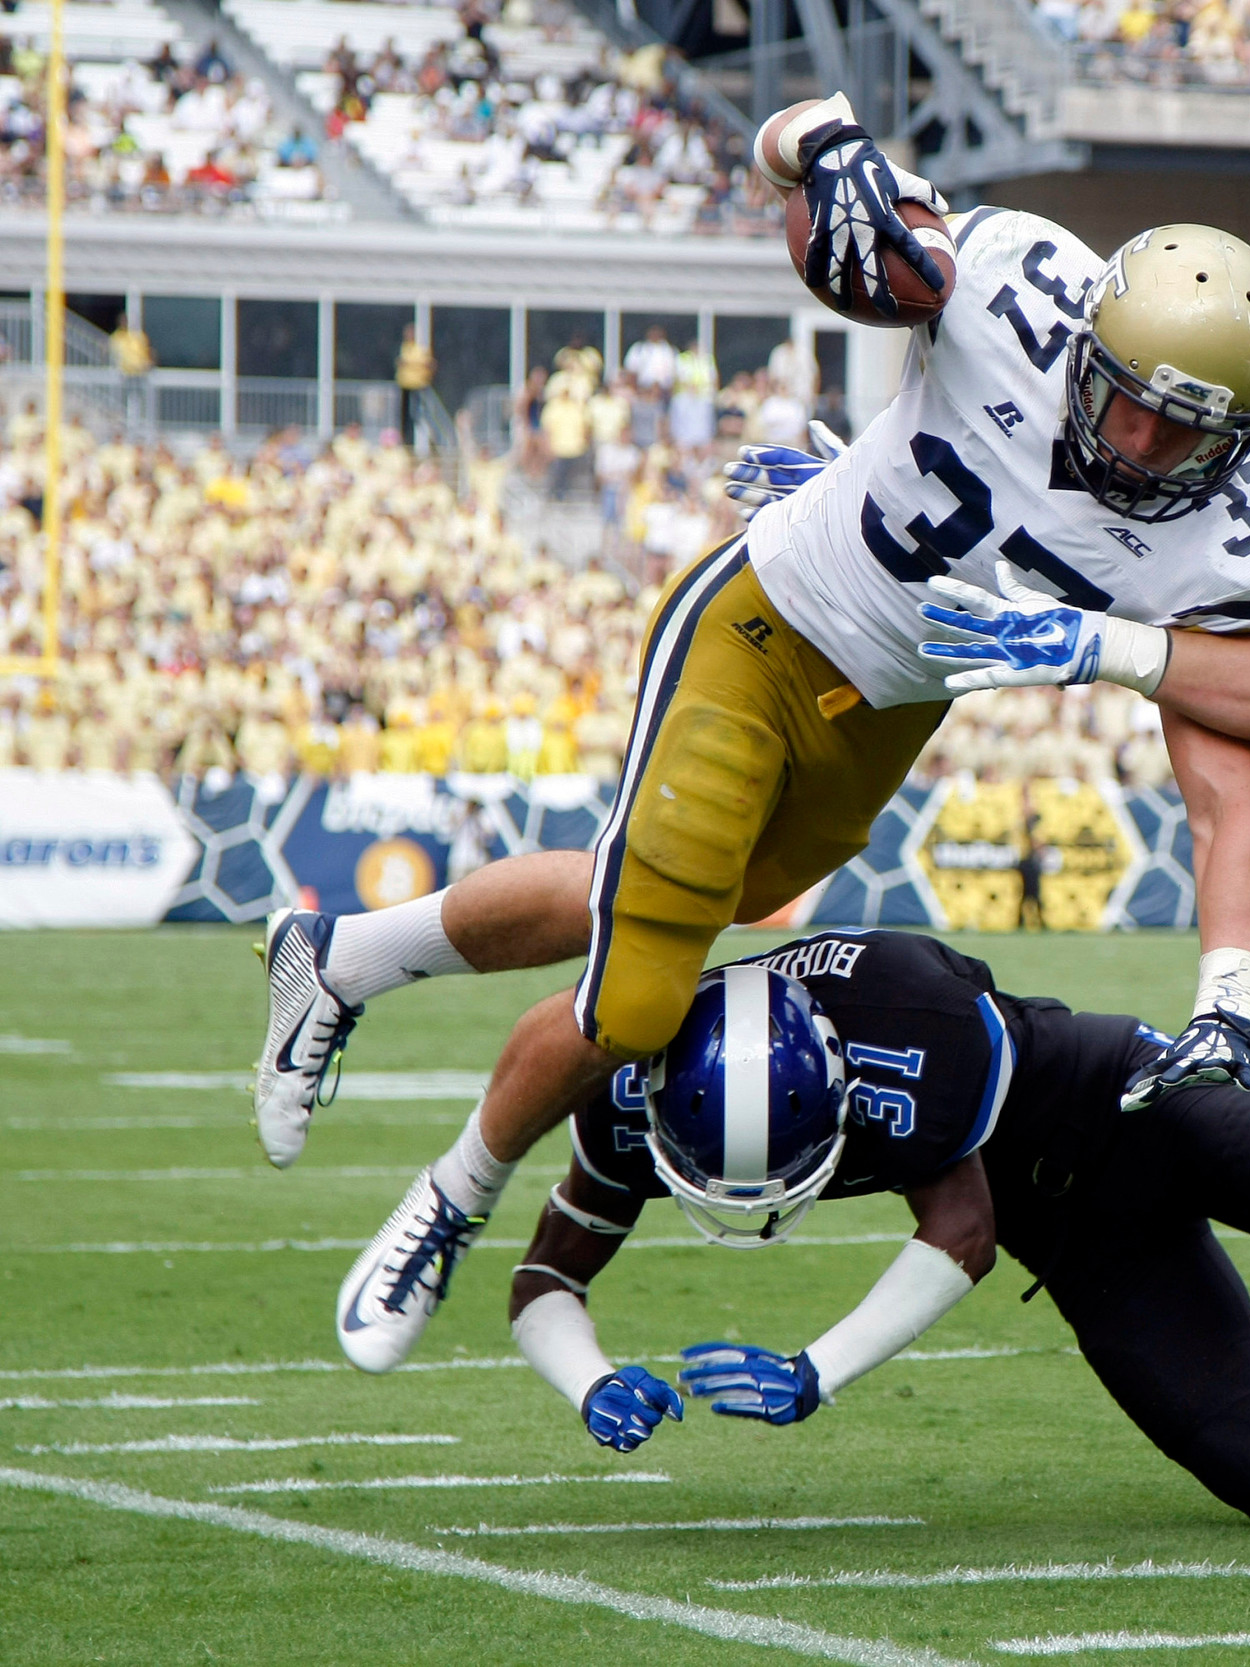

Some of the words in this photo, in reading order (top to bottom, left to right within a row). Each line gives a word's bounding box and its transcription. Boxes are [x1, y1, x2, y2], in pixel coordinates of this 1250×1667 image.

[986, 240, 1095, 375] 37
[1175, 381, 1213, 400] ACC
[1103, 526, 1153, 559] ACC
[846, 1041, 925, 1137] 31
